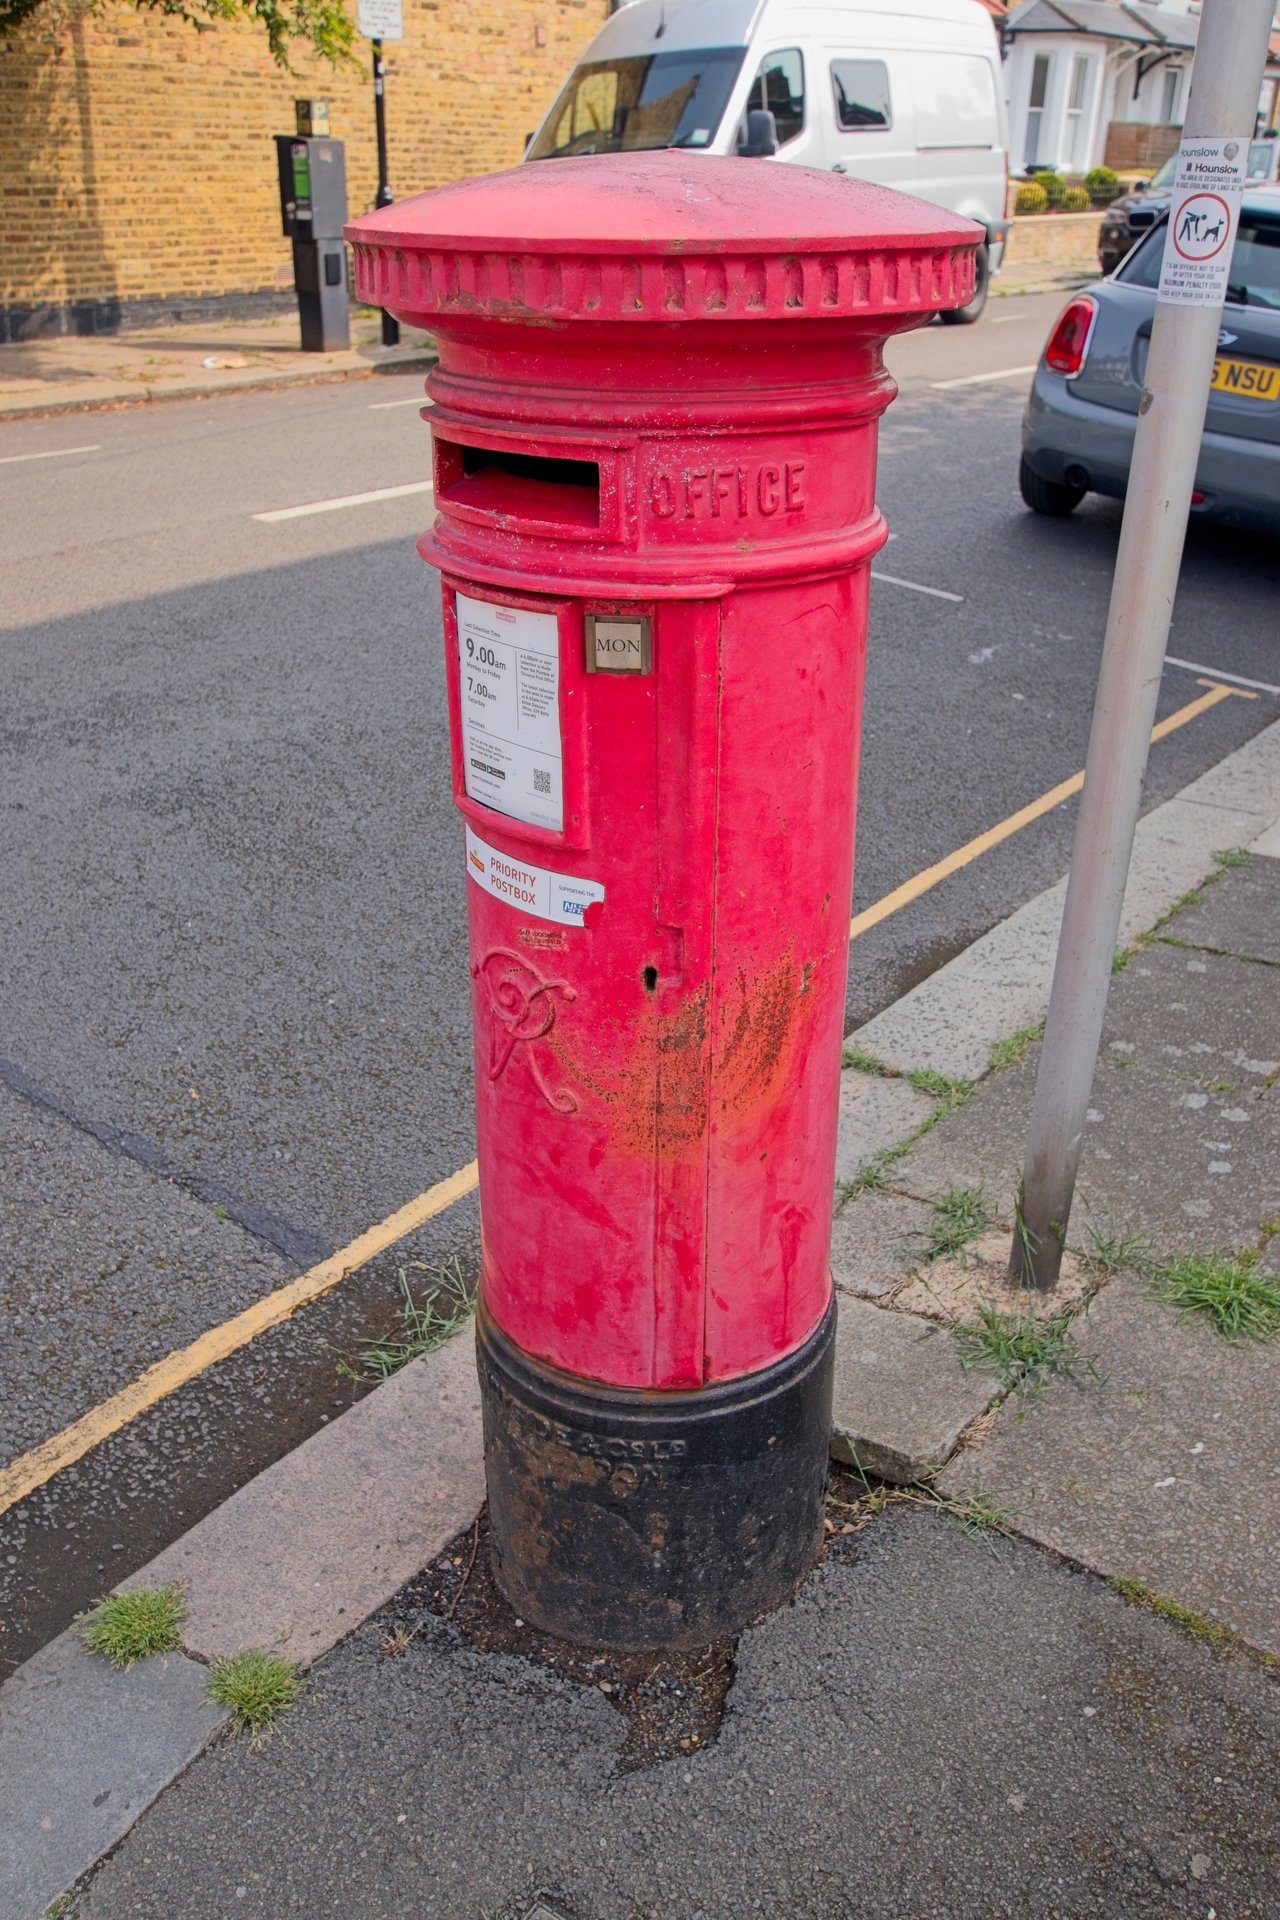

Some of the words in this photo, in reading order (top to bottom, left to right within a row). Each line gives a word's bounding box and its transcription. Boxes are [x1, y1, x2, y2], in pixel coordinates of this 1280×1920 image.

[1181, 147, 1219, 157] ounslow
[1194, 163, 1239, 174] Hounslow
[1225, 364, 1275, 393] NSU
[650, 462, 805, 517] OFFICE
[466, 637, 506, 670] 9.00am
[595, 637, 641, 653] MON
[466, 661, 482, 674] Monday
[487, 669, 501, 680] Friday
[467, 676, 497, 701] 7.00am
[467, 695, 486, 708] Saturday
[468, 717, 485, 729] Services
[490, 857, 537, 888] PRIORITY
[490, 874, 536, 906] POSTBOX
